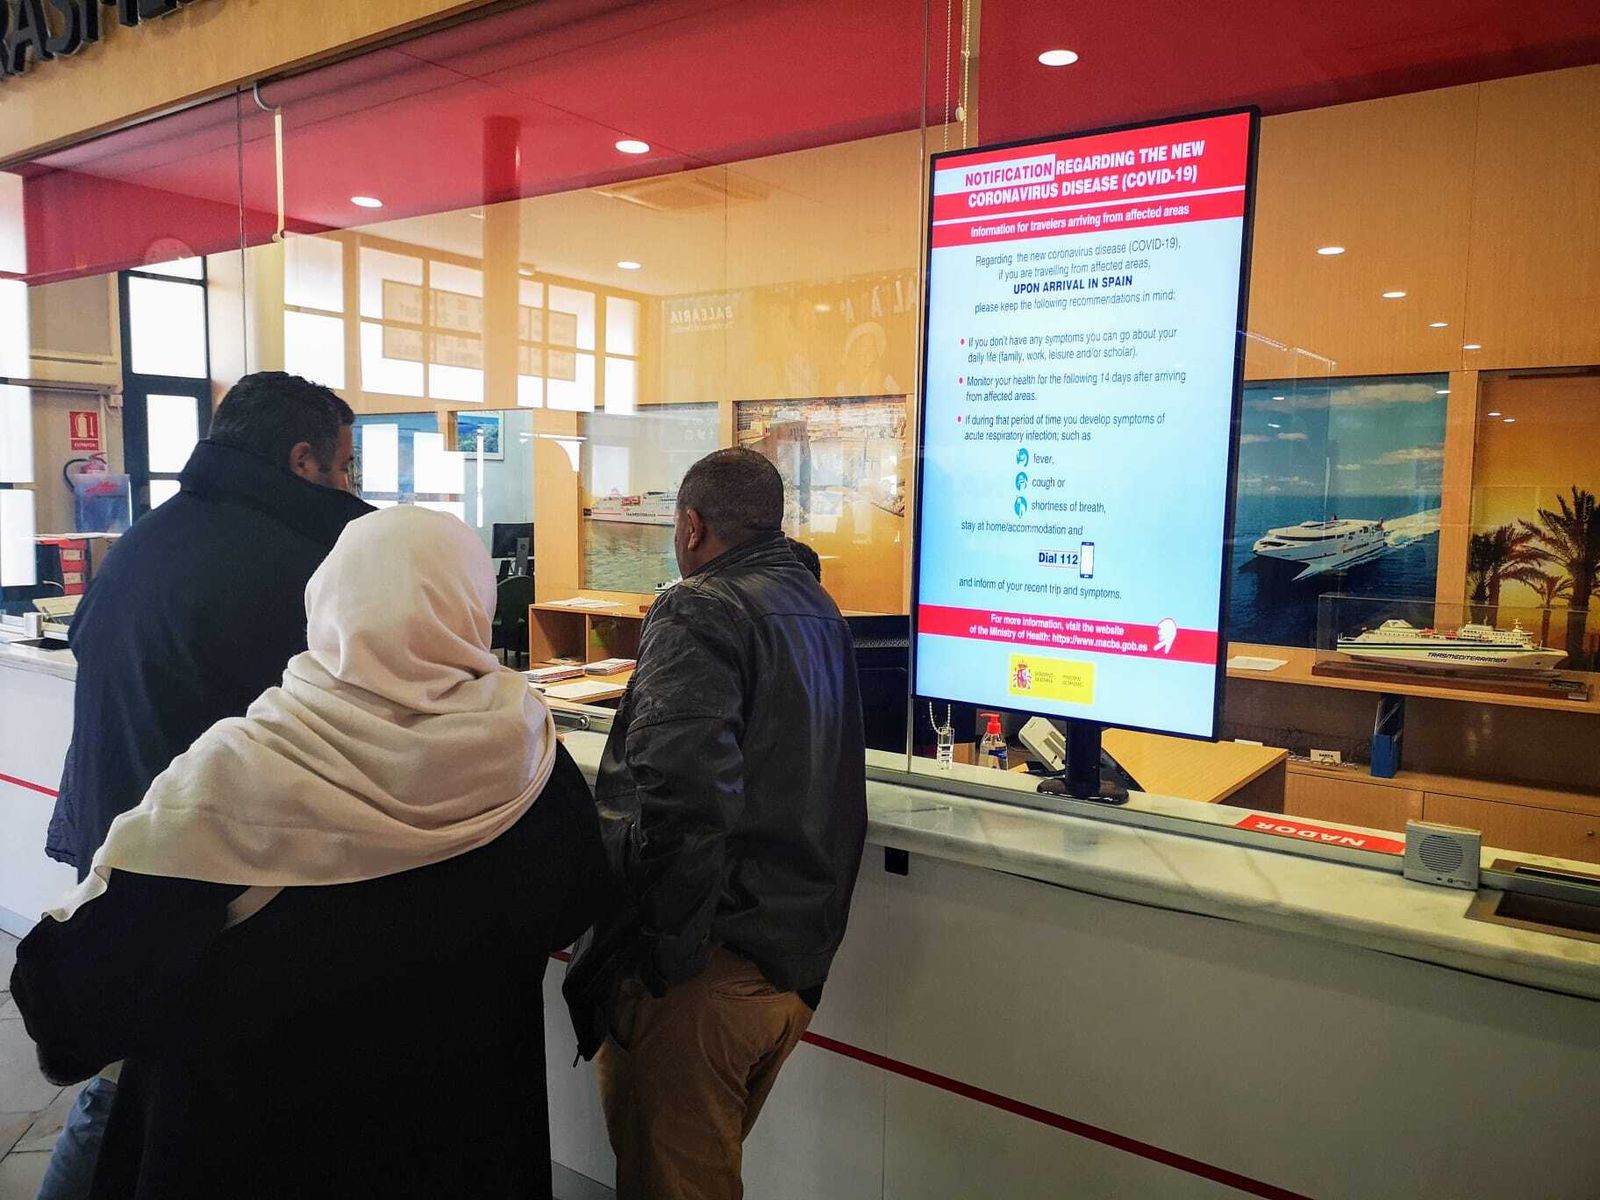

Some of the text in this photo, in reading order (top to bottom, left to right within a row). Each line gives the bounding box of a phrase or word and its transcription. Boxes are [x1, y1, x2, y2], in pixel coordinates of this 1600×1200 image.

[965, 141, 1205, 186] NOTIFICATION REGARDING THE NEW
[969, 165, 1198, 207] CORONAVIRUS DISEASE (COVID-19)
[971, 206, 1190, 237] Information for travelers arriving from affected areas
[976, 254, 1012, 268] Regarding
[1017, 252, 1029, 262] the
[1030, 250, 1046, 260] new
[1048, 246, 1093, 261] coronavirus
[1095, 244, 1126, 257] disease
[1004, 271, 1018, 282] you
[1020, 269, 1032, 278] are
[1035, 264, 1069, 278] travelling
[1071, 263, 1088, 274] from
[1091, 259, 1122, 273] affected
[1014, 275, 1132, 295] UPON ARRIVAL IN SPAIN
[975, 302, 998, 315] please
[1001, 301, 1018, 312] keep
[1020, 300, 1032, 310] the
[1034, 296, 1067, 310] following
[1069, 292, 1140, 307] recommendations
[1142, 291, 1150, 302] in
[975, 339, 988, 350] you
[1010, 336, 1027, 347] have
[1029, 336, 1043, 347] any
[1045, 334, 1084, 346] symptoms
[1086, 333, 1101, 344] you
[1103, 332, 1117, 343] can
[1119, 331, 1130, 344] go
[1132, 329, 1156, 342] about
[1159, 329, 1178, 342] your
[968, 352, 984, 365] daily
[999, 351, 1024, 364] (family,
[1027, 349, 1046, 360] work,
[1049, 349, 1074, 360] leisure
[967, 370, 1186, 388] Monitor your health for the following 14 days after arriving
[966, 391, 982, 402] from
[984, 390, 1013, 401] affected
[972, 415, 993, 428] during
[995, 415, 1009, 425] that
[1011, 414, 1034, 427] period
[1036, 414, 1043, 425] of
[1045, 415, 1061, 424] time
[1063, 416, 1078, 428] you
[1080, 414, 1110, 426] develop
[1113, 414, 1154, 427] symptoms
[1157, 412, 1165, 424] of
[965, 431, 984, 440] acute
[986, 429, 1024, 443] respiratory
[1061, 430, 1079, 440] such
[1082, 432, 1091, 440] as
[1032, 477, 1065, 490] cough or
[1032, 500, 1106, 514] shortness of breath,
[961, 520, 975, 533] stay
[978, 521, 984, 532] at
[1068, 526, 1083, 536] and
[1039, 552, 1078, 565] Dial 112
[960, 577, 972, 587] and
[974, 578, 996, 589] inform
[998, 580, 1005, 590] of
[1007, 581, 1022, 593] your
[1024, 584, 1047, 593] recent
[1050, 584, 1061, 597] trip
[1063, 585, 1078, 595] and
[969, 625, 977, 633] of
[978, 626, 988, 635] the
[990, 627, 1016, 639] Ministry
[1018, 630, 1025, 638] of
[1027, 631, 1050, 641] Health:
[991, 614, 1002, 623] For
[1004, 617, 1021, 625] more
[1066, 622, 1080, 631] visit
[1082, 623, 1094, 632] the
[1096, 625, 1124, 635] website
[1255, 821, 1366, 847] NADOR
